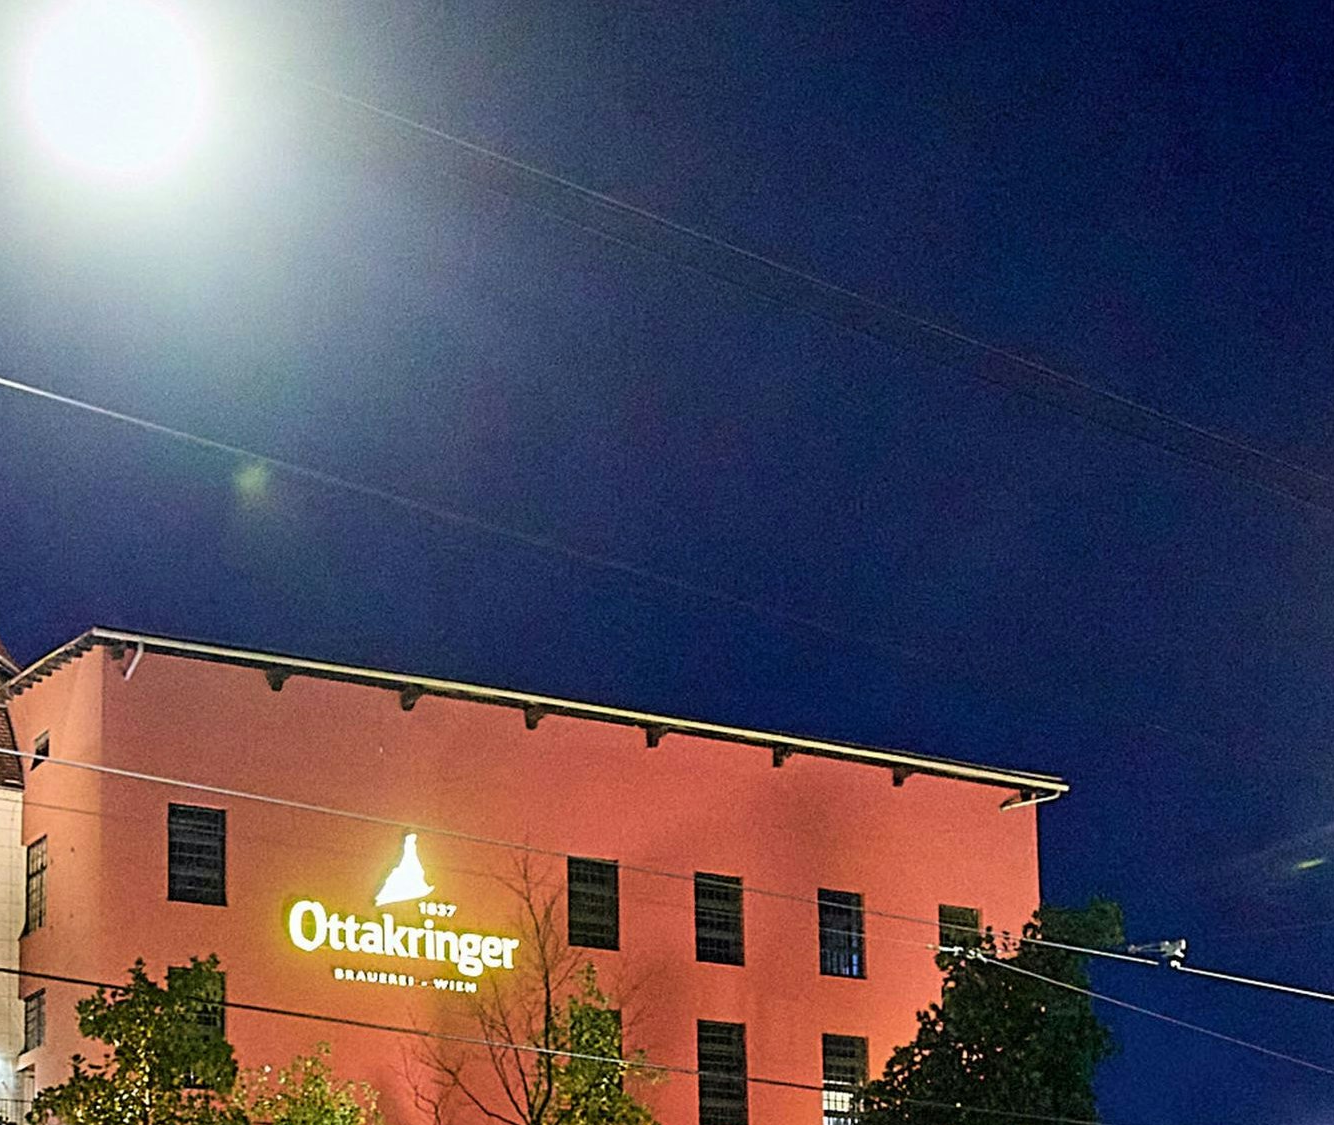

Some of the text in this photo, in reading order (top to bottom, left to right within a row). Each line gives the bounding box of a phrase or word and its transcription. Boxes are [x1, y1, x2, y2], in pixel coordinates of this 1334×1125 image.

[289, 900, 520, 977] Ottakringer
[334, 967, 415, 988] BRAUEREI
[433, 978, 478, 993] WIEN
